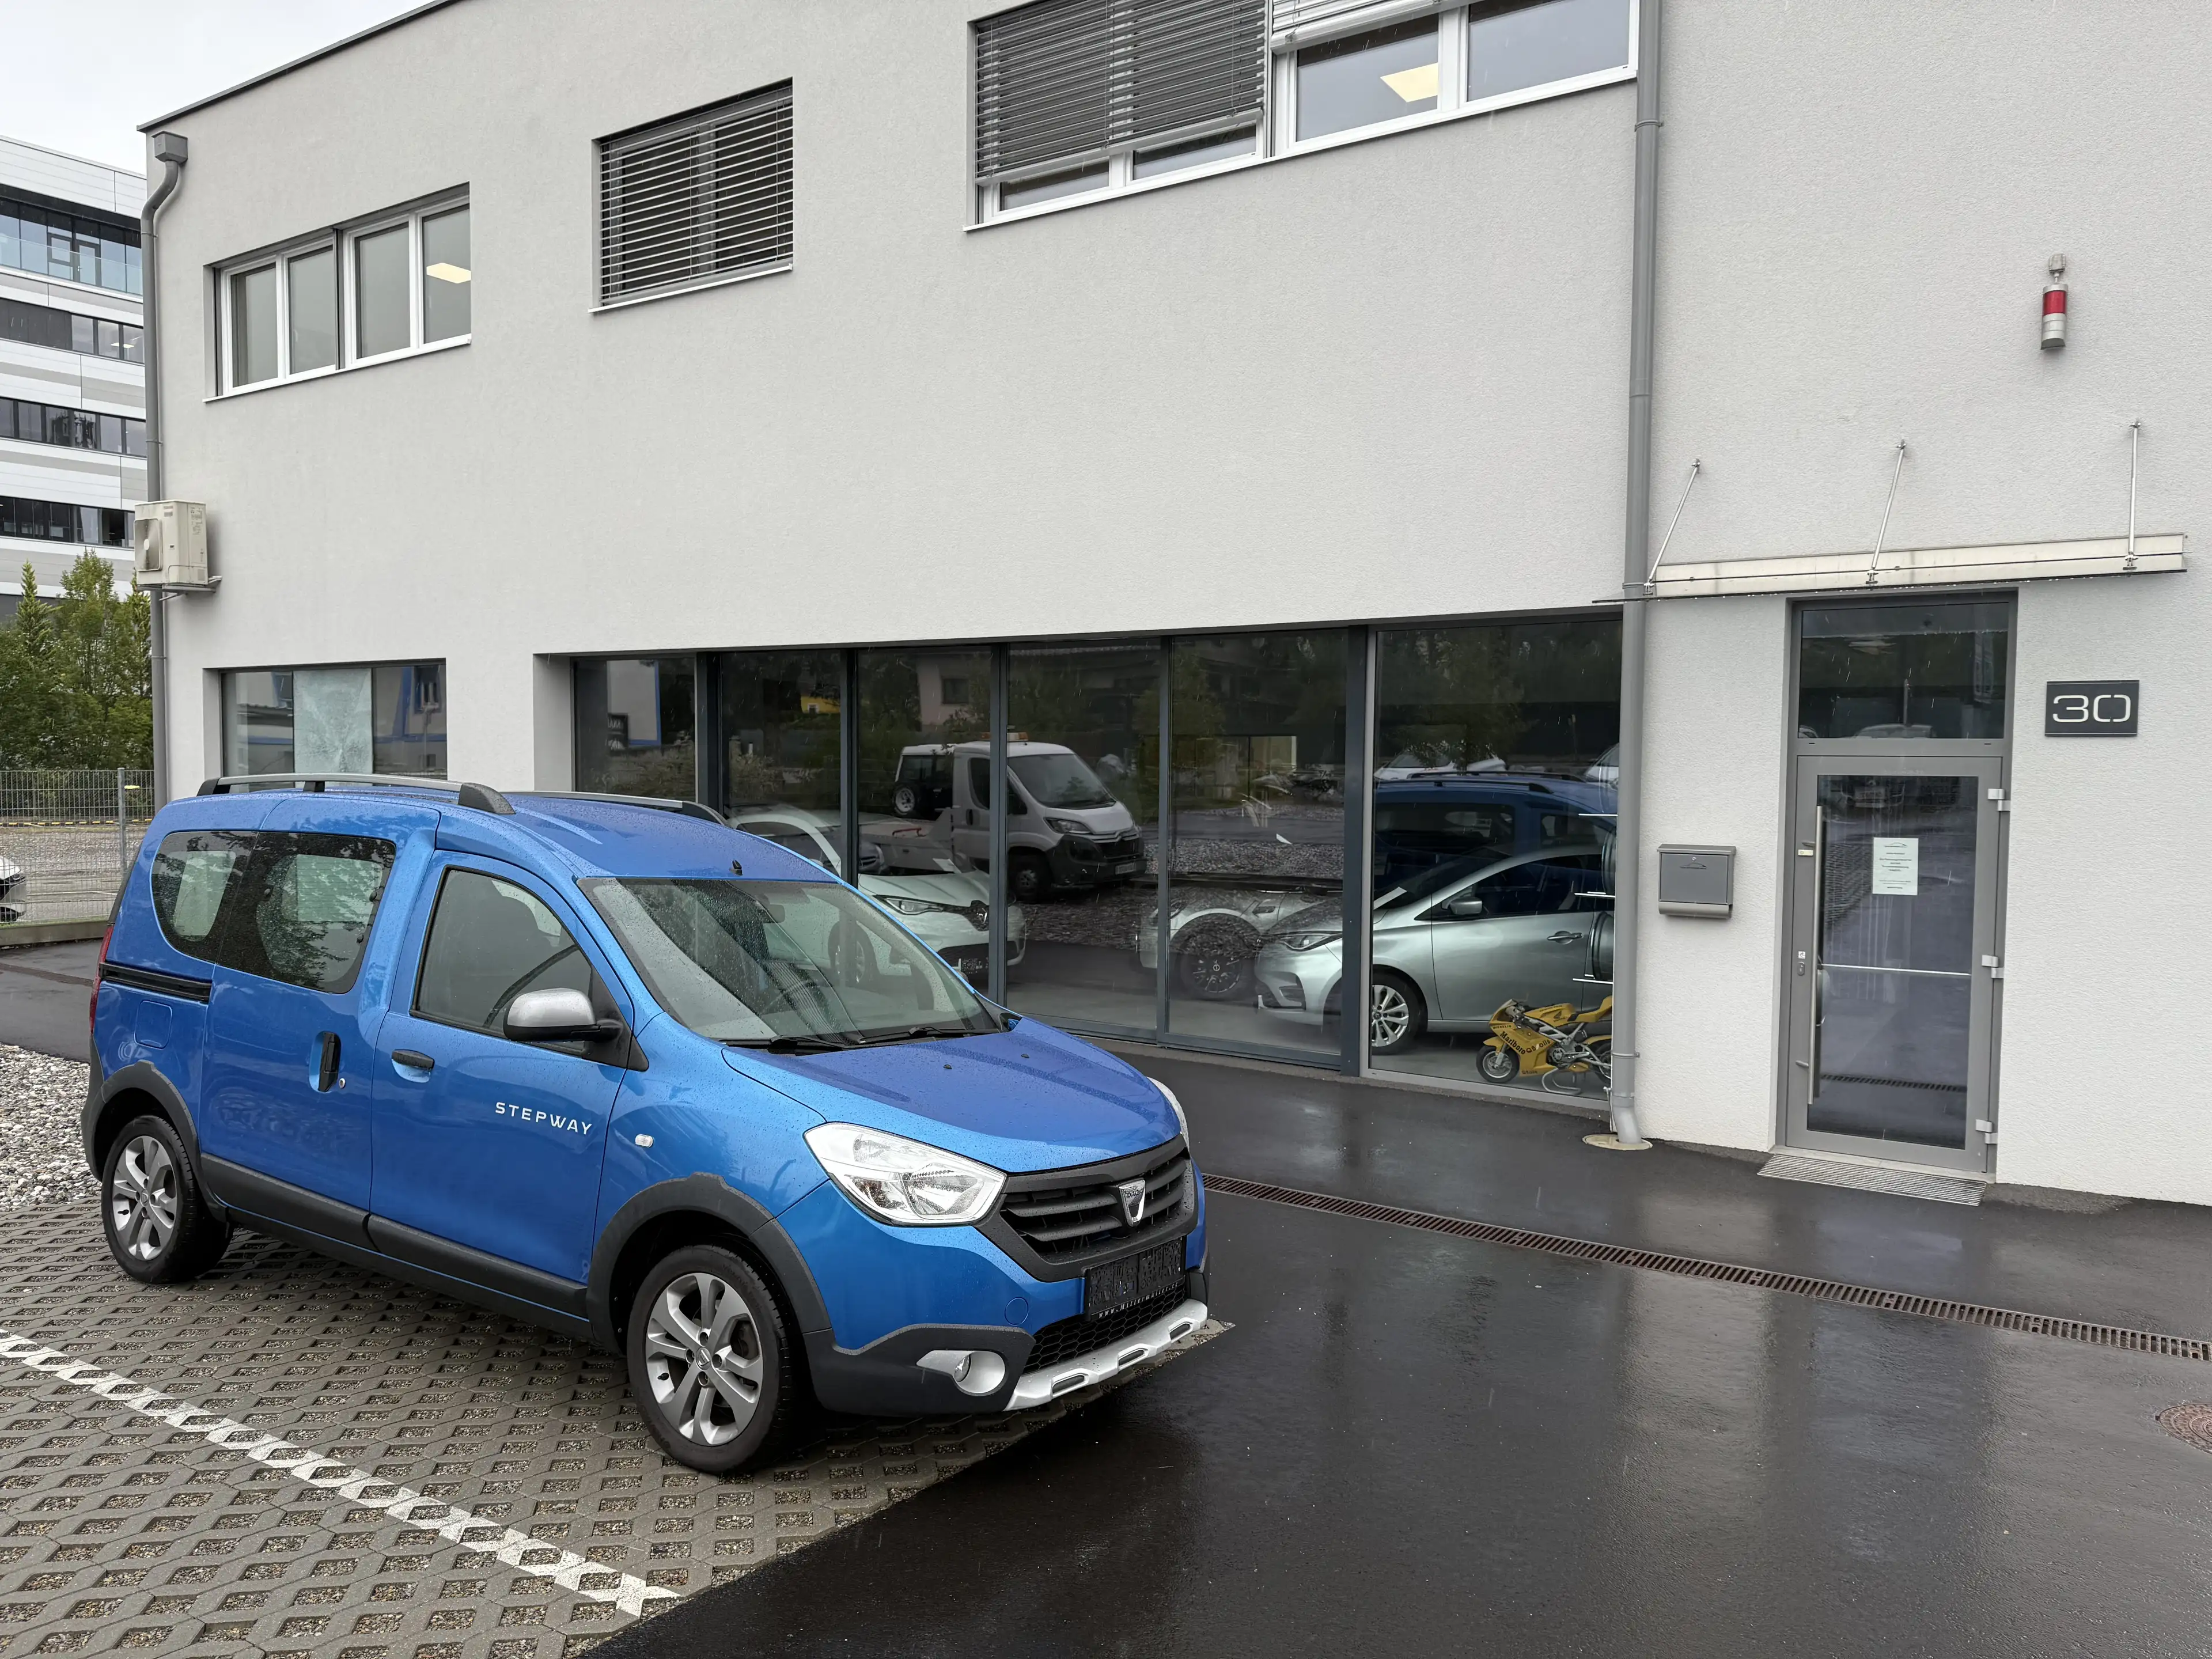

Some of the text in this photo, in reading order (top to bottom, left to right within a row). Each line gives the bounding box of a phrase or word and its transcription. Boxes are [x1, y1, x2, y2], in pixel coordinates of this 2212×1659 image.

[2052, 694, 2131, 722] 30
[1499, 1031, 1526, 1055] Marlboro
[495, 1101, 592, 1135] STEPWAY
[1127, 1188, 1143, 1198] DACIA
